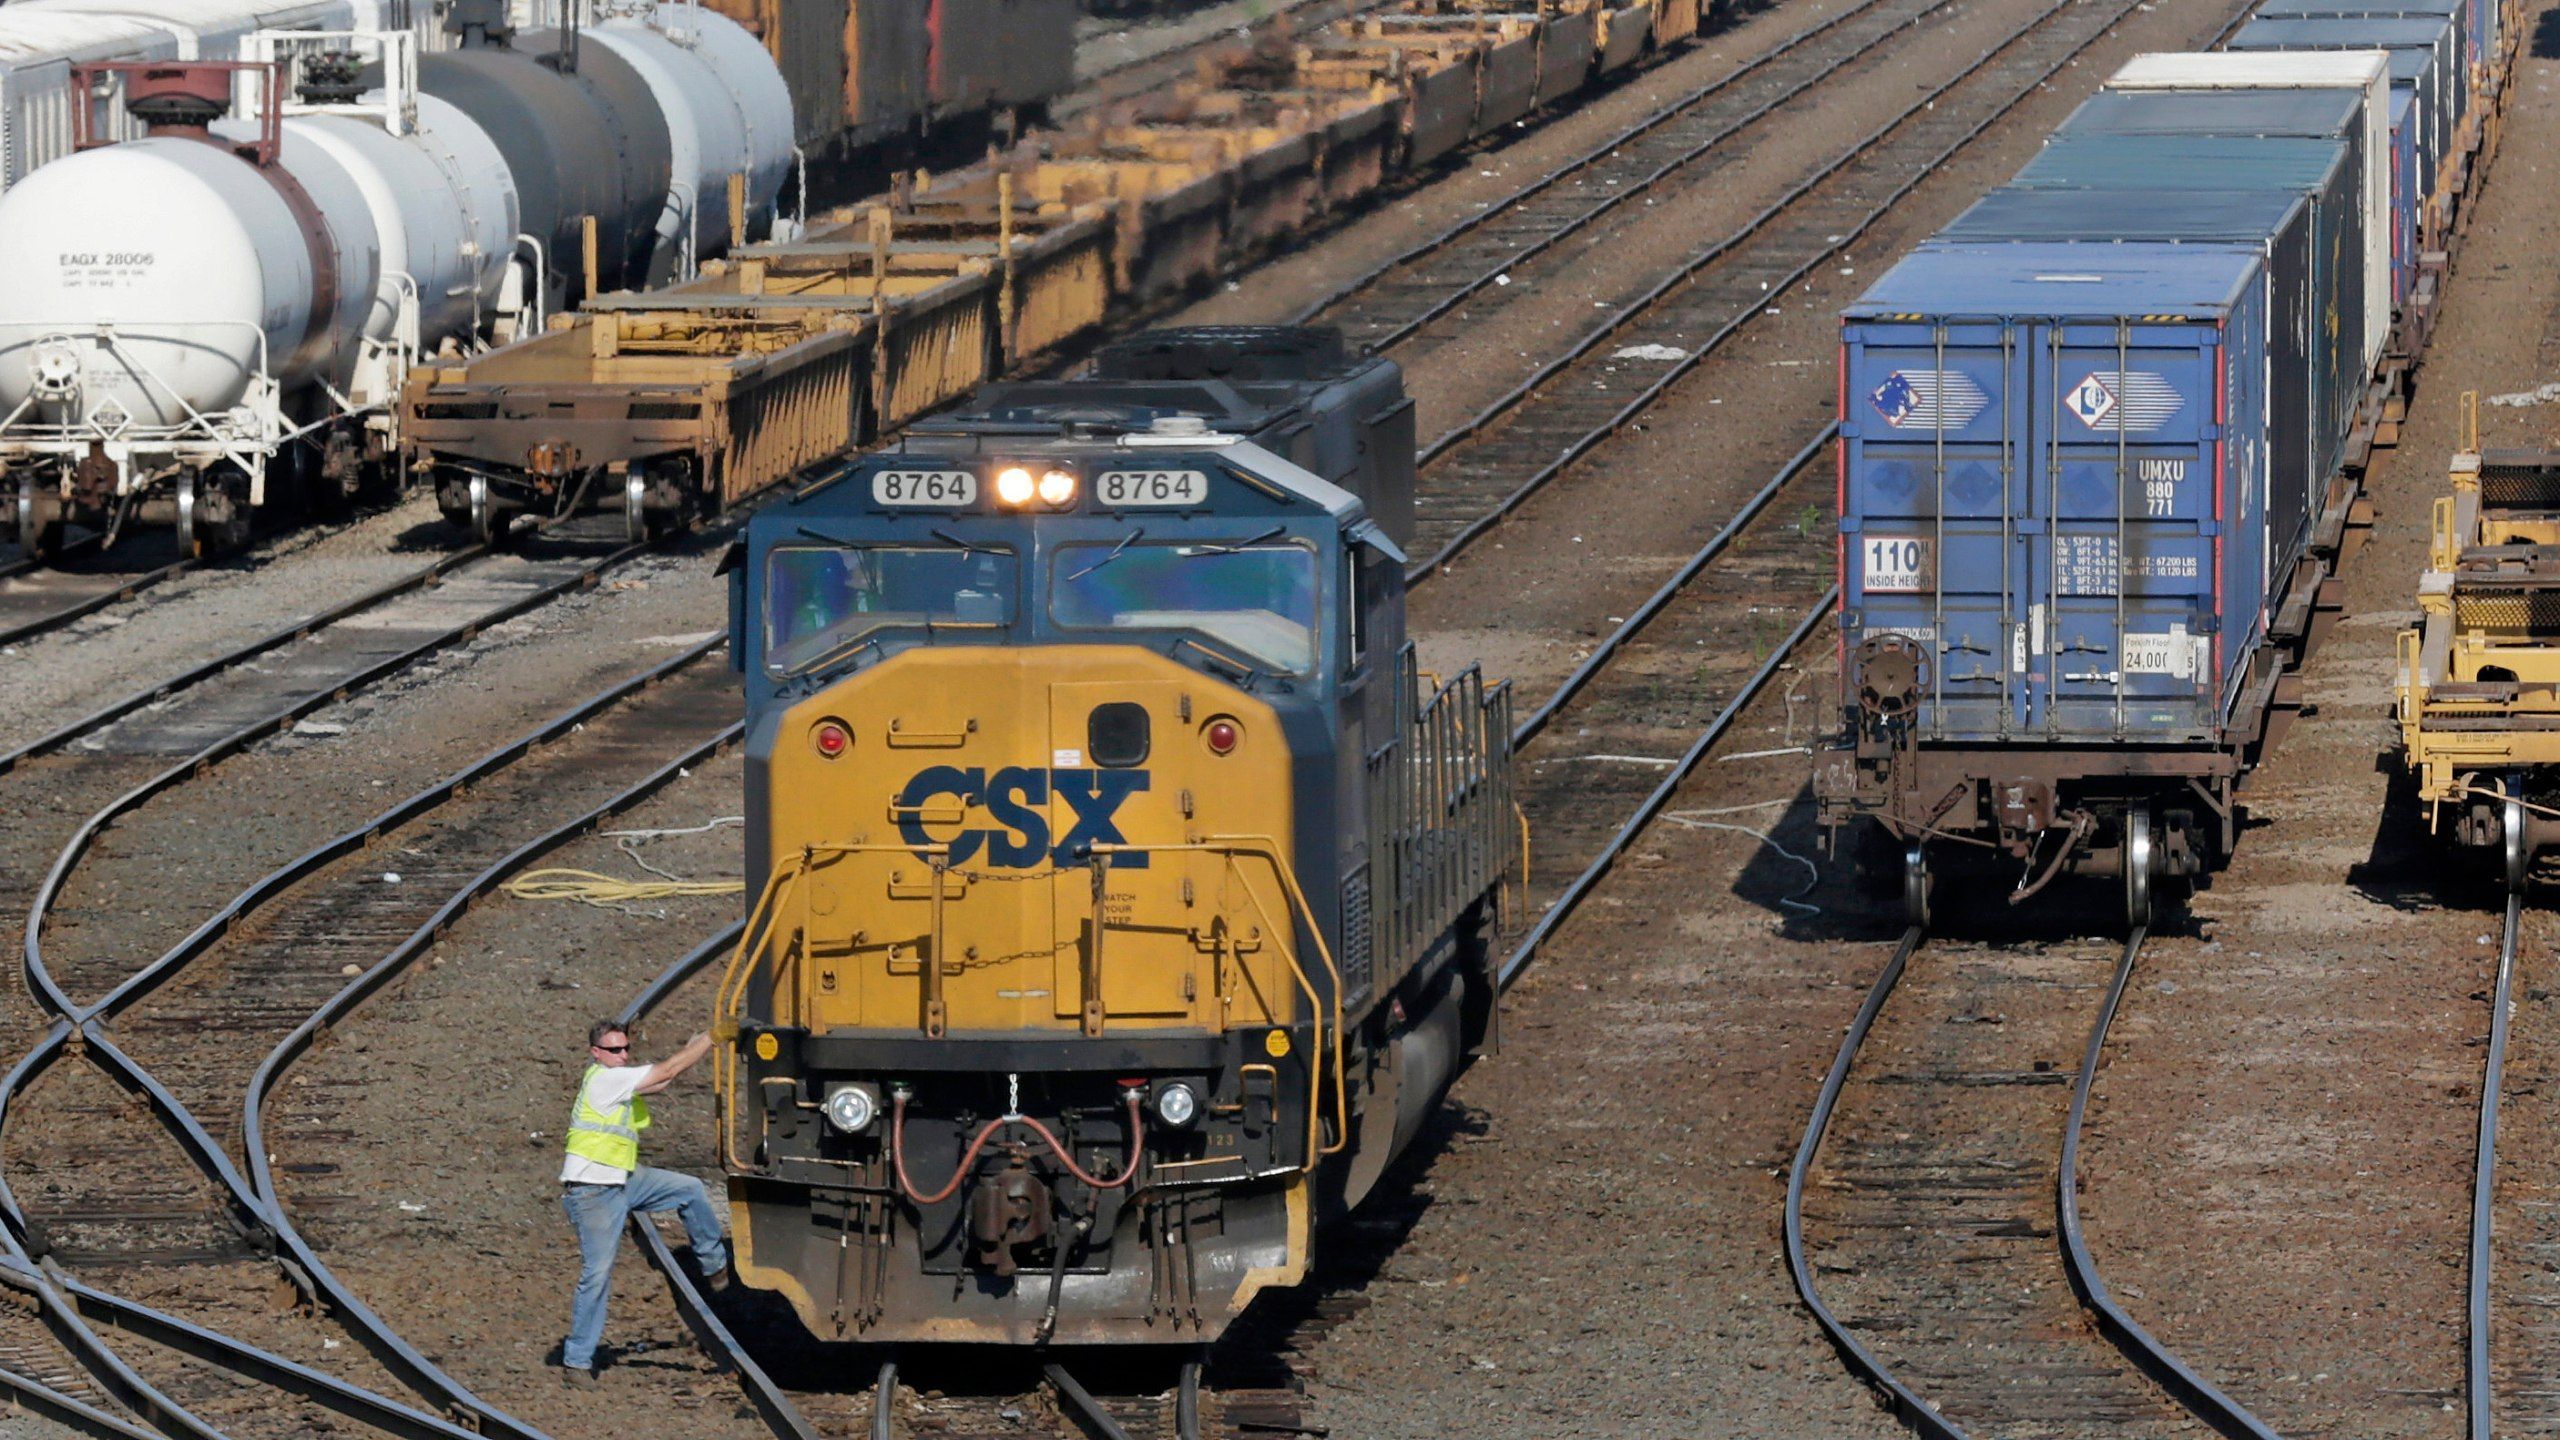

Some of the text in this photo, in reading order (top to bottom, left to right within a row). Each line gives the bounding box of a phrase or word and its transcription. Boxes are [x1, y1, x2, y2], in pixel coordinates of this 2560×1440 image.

[2139, 459, 2184, 481] UMXU
[885, 474, 967, 500] 8764
[1106, 474, 1193, 500] 8764
[2146, 481, 2173, 498] 880
[2146, 498, 2173, 515] 771
[2182, 557, 2197, 567] LBS
[2182, 567, 2197, 577] LBS
[1866, 575, 1931, 587] INSIDE HEIGHT
[898, 765, 1150, 869] CSX
[1105, 916, 1132, 924] STEP
